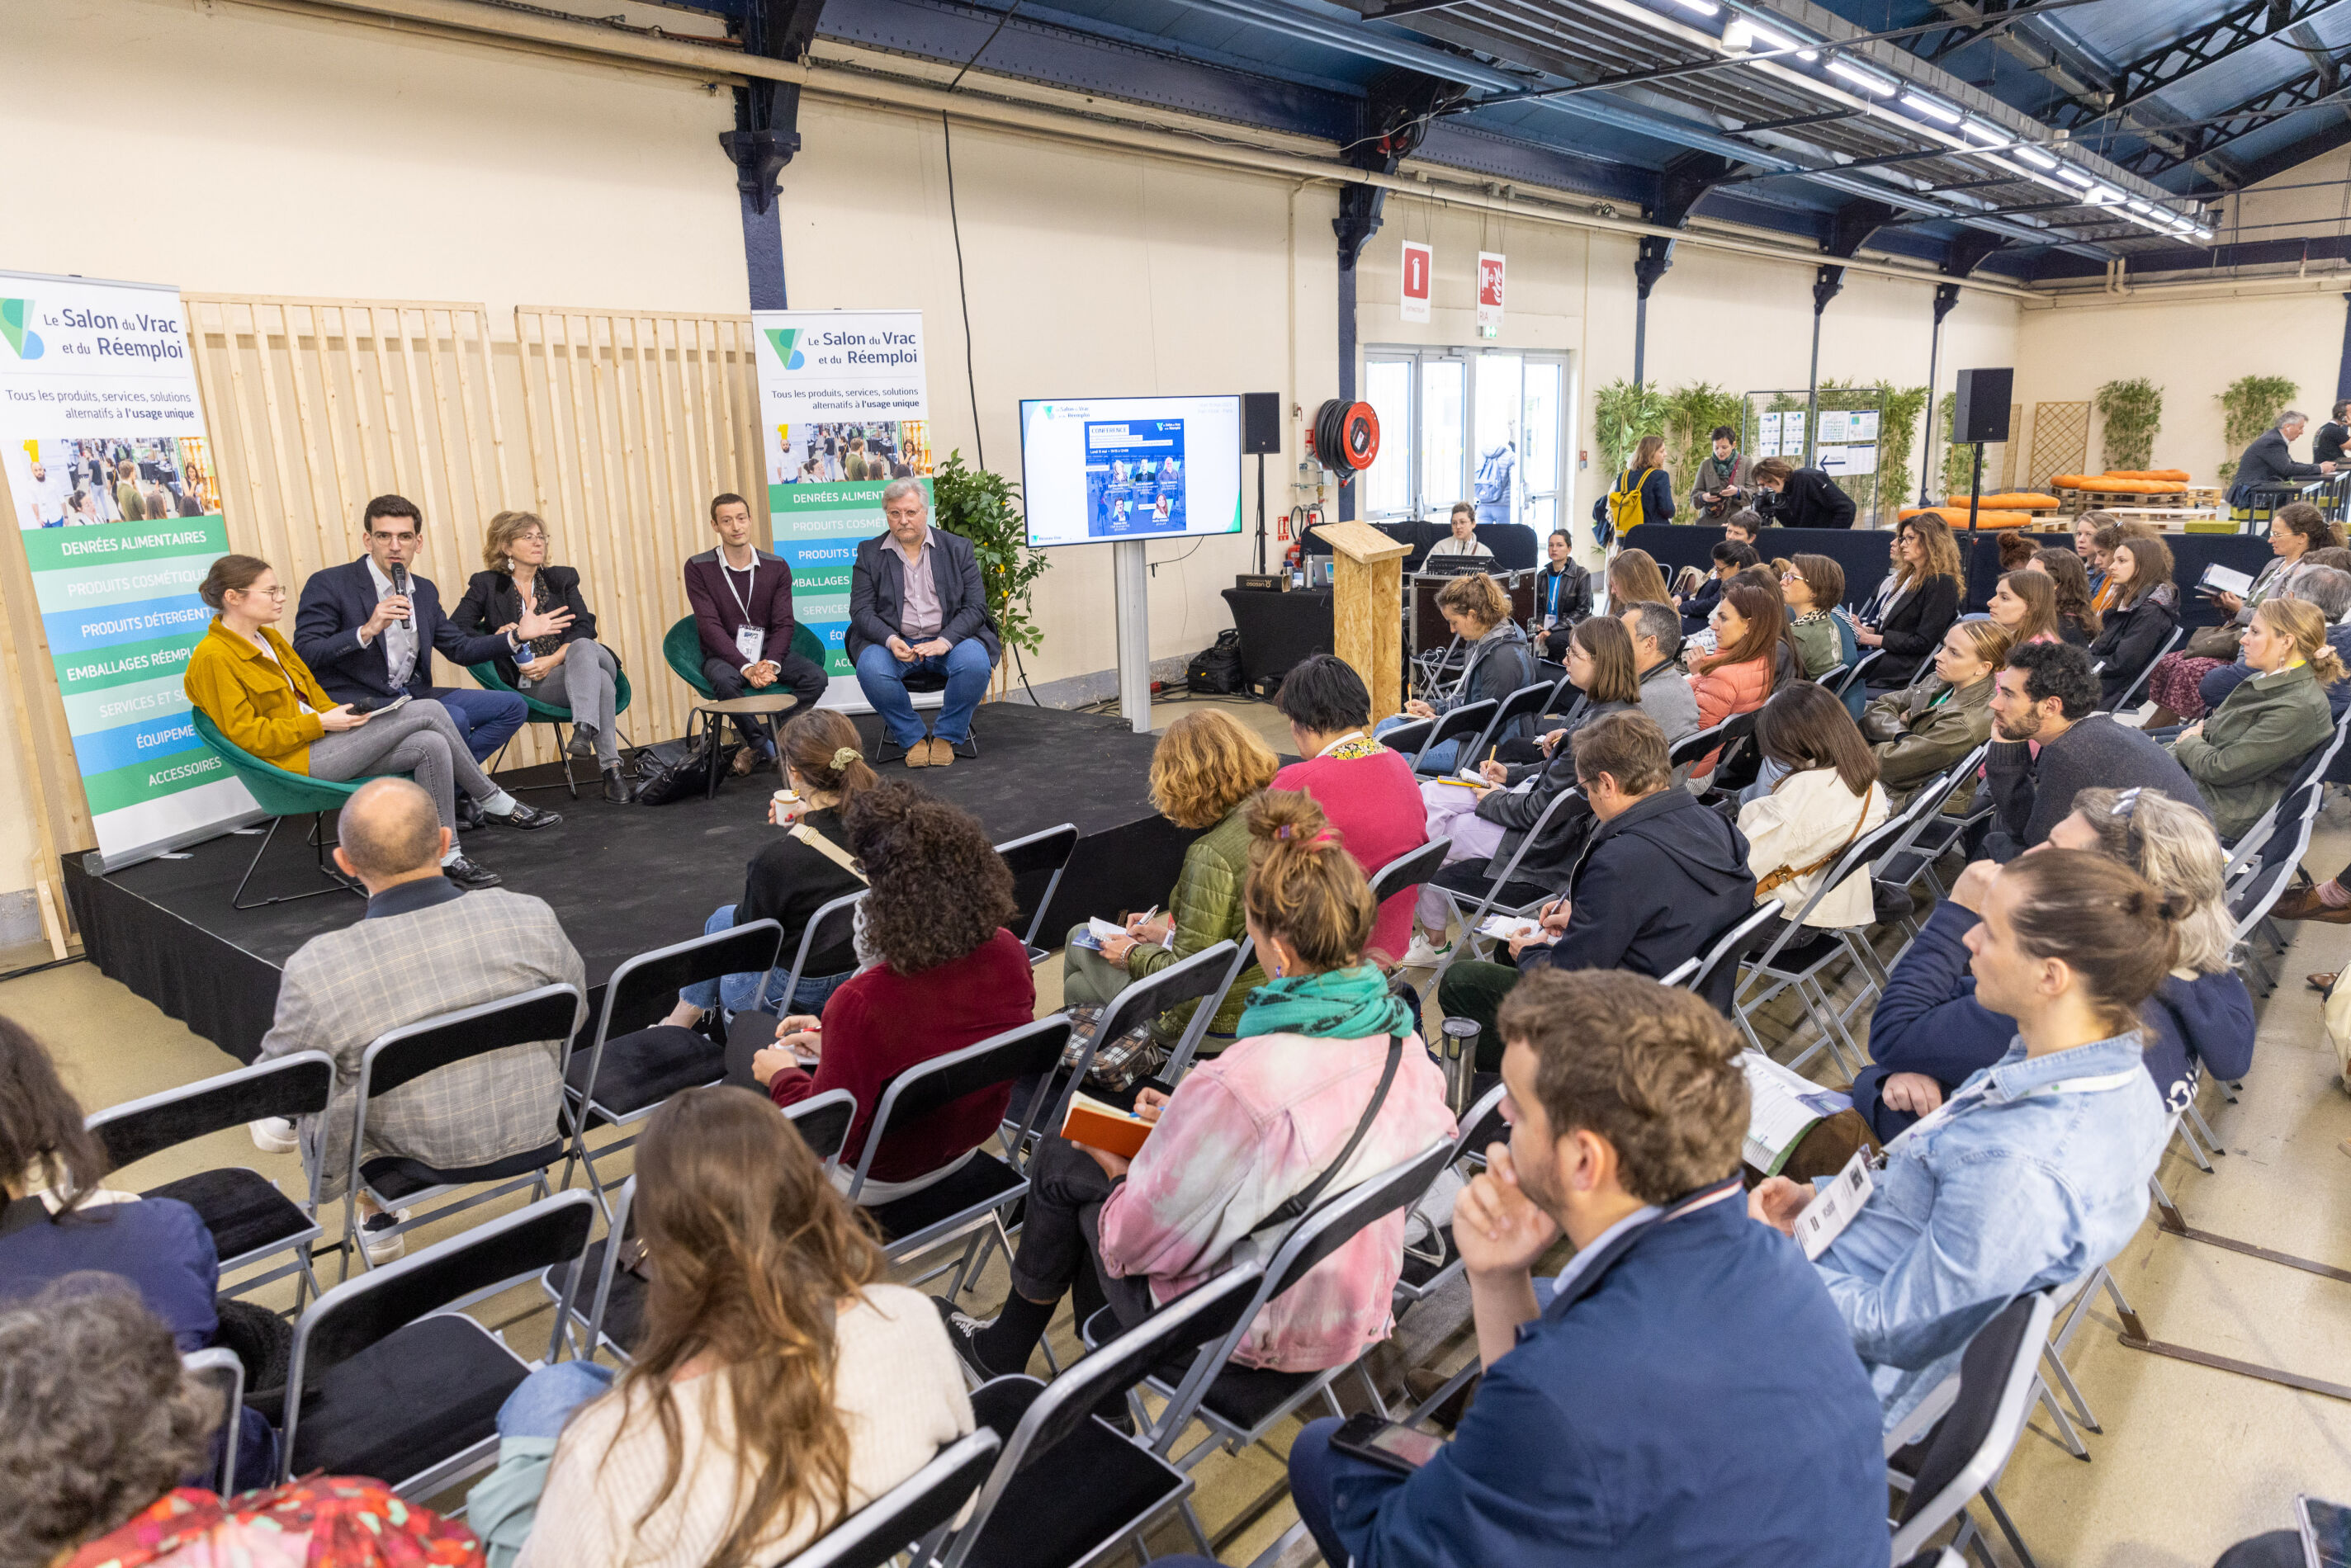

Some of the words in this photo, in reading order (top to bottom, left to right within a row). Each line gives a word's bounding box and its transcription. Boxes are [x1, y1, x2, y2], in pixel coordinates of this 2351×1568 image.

[44, 314, 59, 327] Le
[63, 309, 119, 330] Salon
[122, 318, 136, 331] du
[136, 314, 179, 334] Vrac
[1478, 311, 1489, 323] RIA
[807, 338, 820, 346] Le
[822, 332, 866, 346] Salon
[869, 337, 881, 345] du
[882, 332, 916, 345] Vrac
[63, 342, 74, 354] et
[77, 342, 91, 355] du
[97, 337, 184, 361] Réemploi
[818, 357, 828, 365] et
[830, 355, 842, 364] du
[848, 349, 918, 366] Réemploi
[5, 390, 36, 401] Tous
[38, 390, 55, 402] les
[57, 390, 101, 406] produits,
[102, 391, 149, 404] services,
[150, 391, 192, 404] solutions
[771, 390, 792, 399] Tous
[794, 390, 807, 399] les
[808, 389, 844, 400] produits,
[845, 389, 881, 398] services,
[882, 387, 919, 396] solutions
[812, 400, 854, 410] alternatifs
[855, 400, 861, 409] à
[862, 400, 892, 411] l'usage
[892, 399, 920, 410] unique
[65, 407, 114, 419] alternatifs
[116, 408, 123, 419] à
[125, 408, 163, 421] l'usage
[164, 408, 195, 421] unique
[793, 490, 839, 503] DENRÉES
[841, 490, 885, 502] ALIMENT
[792, 520, 844, 532] PRODUITS
[846, 516, 887, 529] COSMÉT
[61, 536, 119, 556] DENRÉES
[121, 531, 207, 550] ALIMENTAIRES
[798, 548, 849, 560] PRODUITS
[67, 578, 130, 598] PRODUITS
[132, 569, 211, 589] COSMÉTIQUE
[792, 576, 850, 588] MBALLAGES
[802, 604, 849, 616] SERVICES
[81, 616, 143, 638] PRODUITS
[144, 606, 215, 628] DÉTERGENT
[66, 655, 149, 682] EMBALLAGES
[150, 646, 196, 667] RÉEMPL
[98, 696, 155, 719] SERVICES
[158, 692, 171, 706] ET
[135, 724, 196, 749] ÉQUIPEME
[149, 756, 222, 786] ACCESSOIRES
